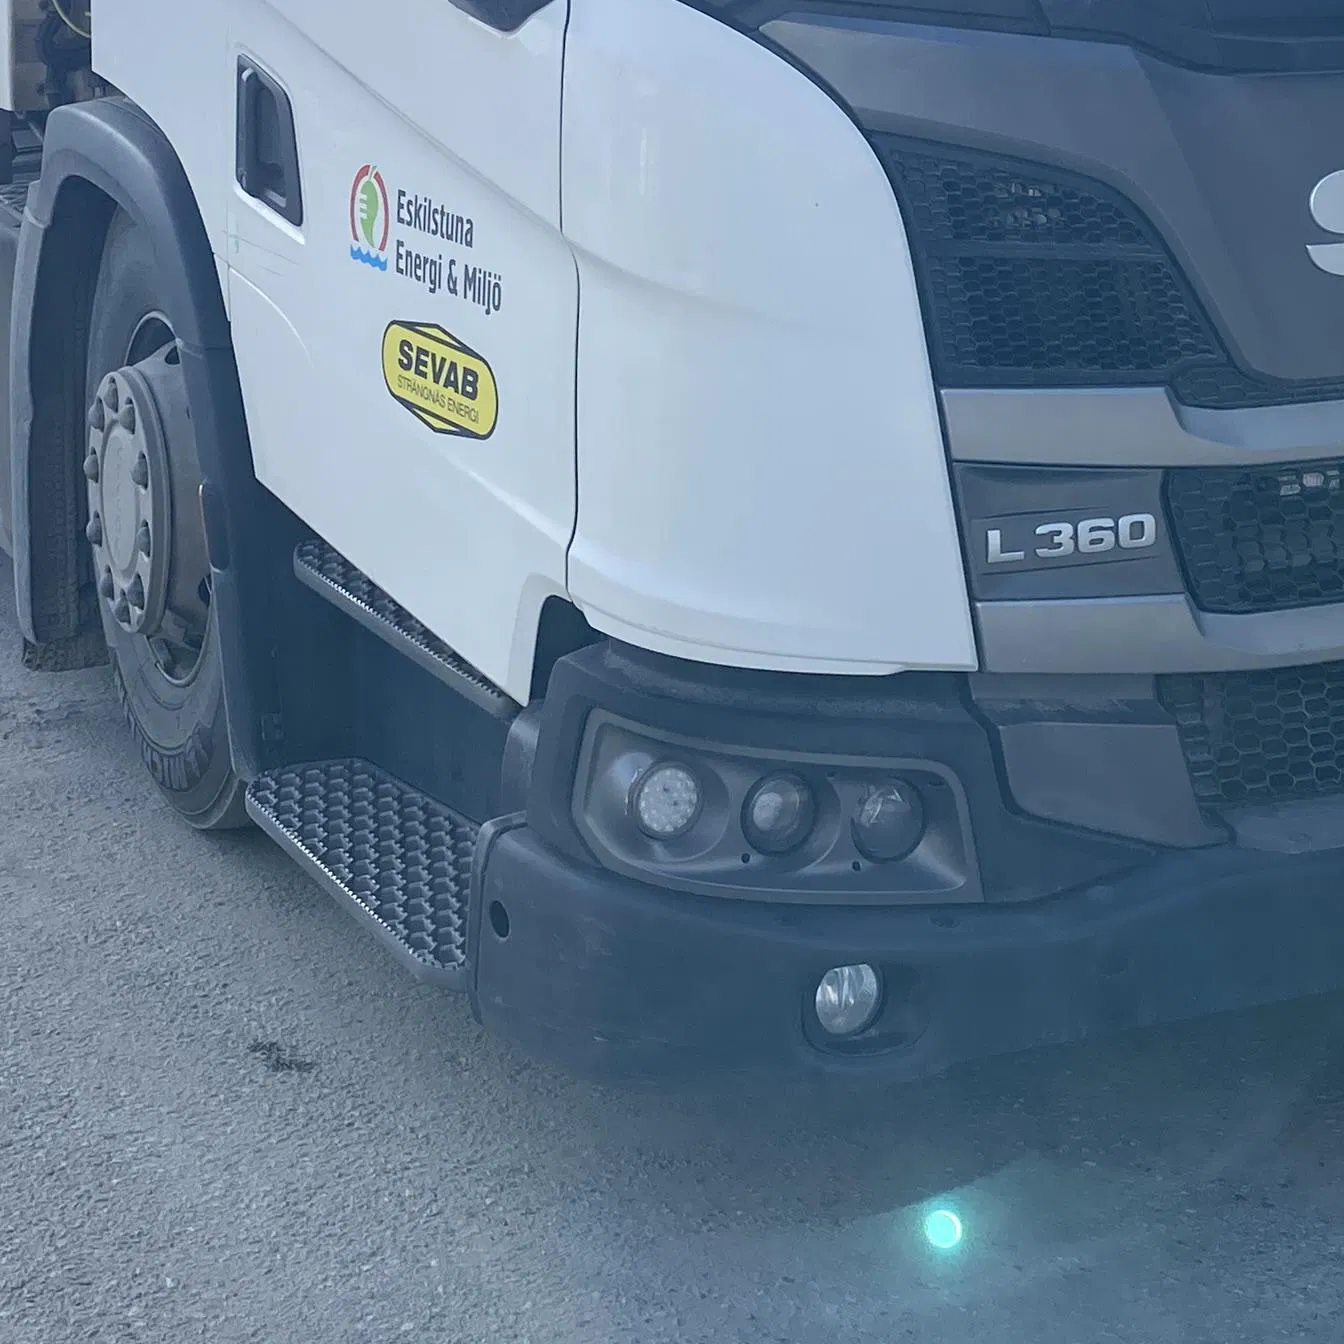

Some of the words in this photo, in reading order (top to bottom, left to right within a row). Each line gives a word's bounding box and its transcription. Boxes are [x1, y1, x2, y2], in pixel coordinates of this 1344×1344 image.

[396, 188, 475, 249] Eskilstuna
[395, 239, 443, 294] Energi
[447, 258, 458, 297] &
[463, 263, 503, 316] Miljö
[398, 339, 479, 401] SEVAB
[447, 397, 480, 424] ENERGI
[986, 529, 1025, 564] L
[1034, 513, 1156, 558] 360
